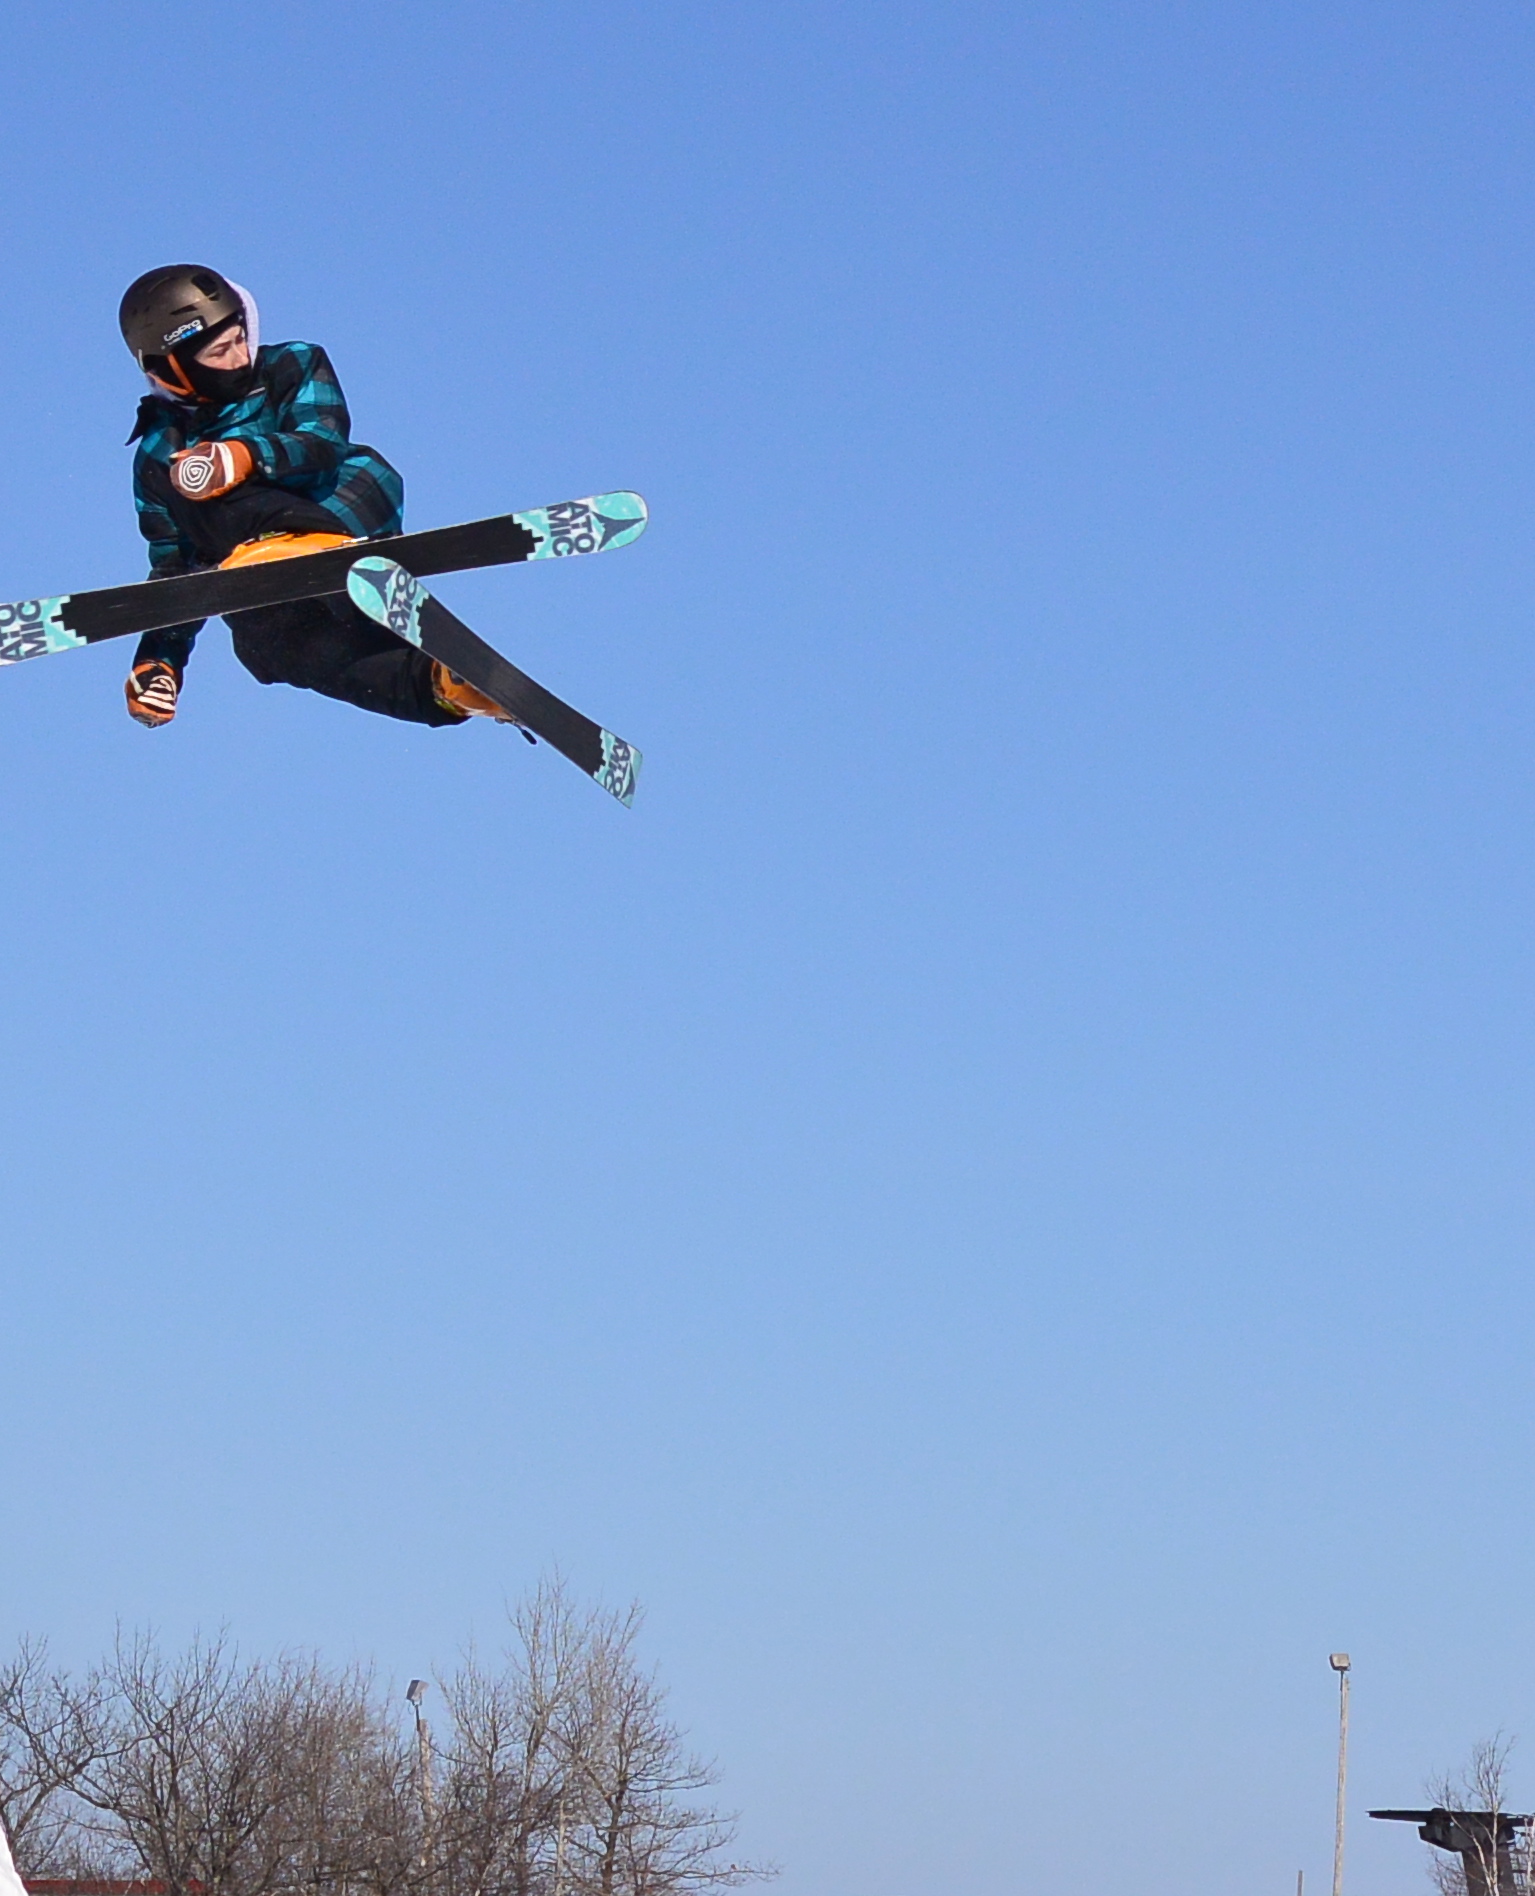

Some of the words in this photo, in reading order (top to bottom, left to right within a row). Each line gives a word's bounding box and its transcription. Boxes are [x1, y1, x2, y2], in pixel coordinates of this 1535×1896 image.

[163, 319, 200, 341] GoPro
[547, 502, 574, 556] MIC
[570, 502, 595, 553] ATO
[16, 600, 48, 660] MIC
